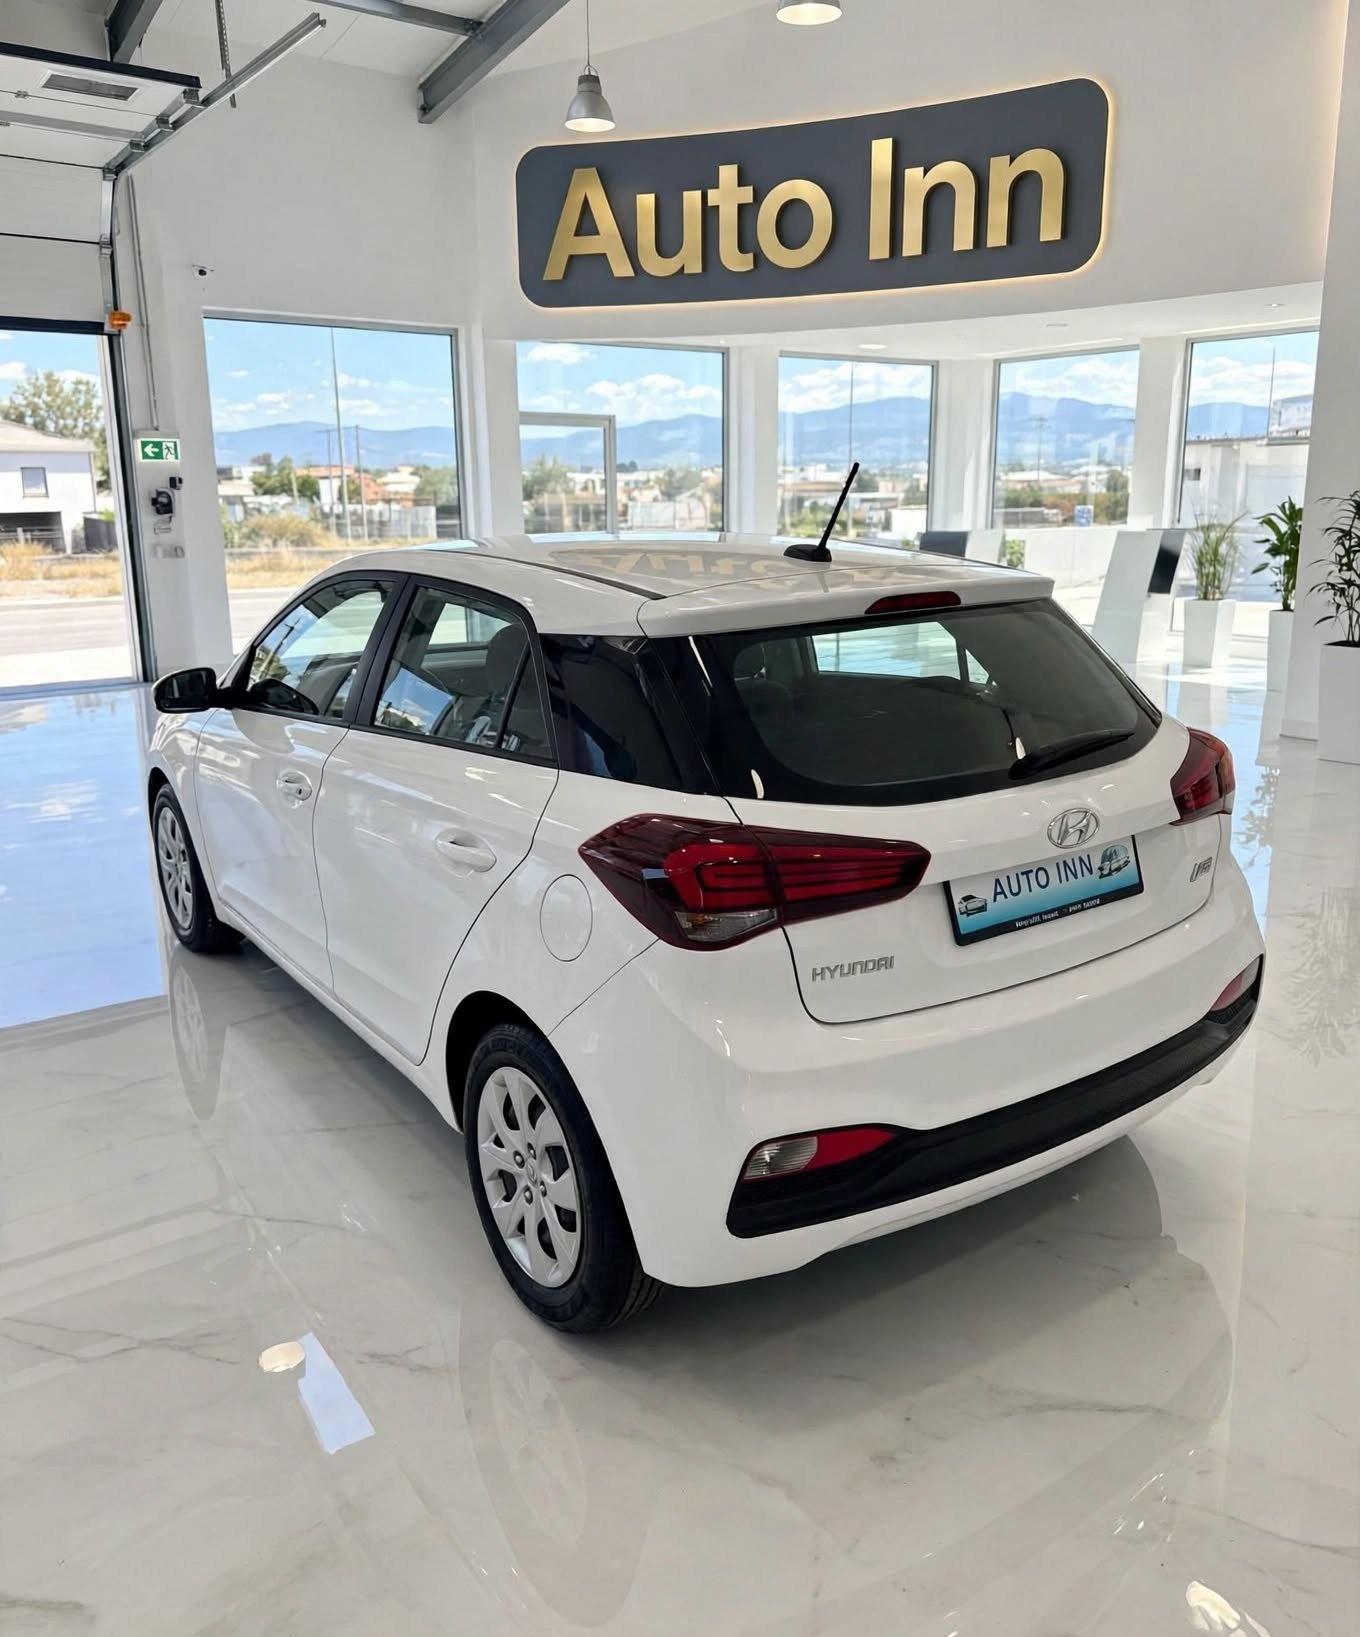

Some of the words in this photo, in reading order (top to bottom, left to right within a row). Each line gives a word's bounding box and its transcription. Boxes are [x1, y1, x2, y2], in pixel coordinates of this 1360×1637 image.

[543, 164, 832, 280] Auto
[869, 137, 1064, 260] Inn
[993, 866, 1050, 902] AUTO
[1056, 854, 1094, 884] INN
[812, 956, 894, 982] HYUNDAI
